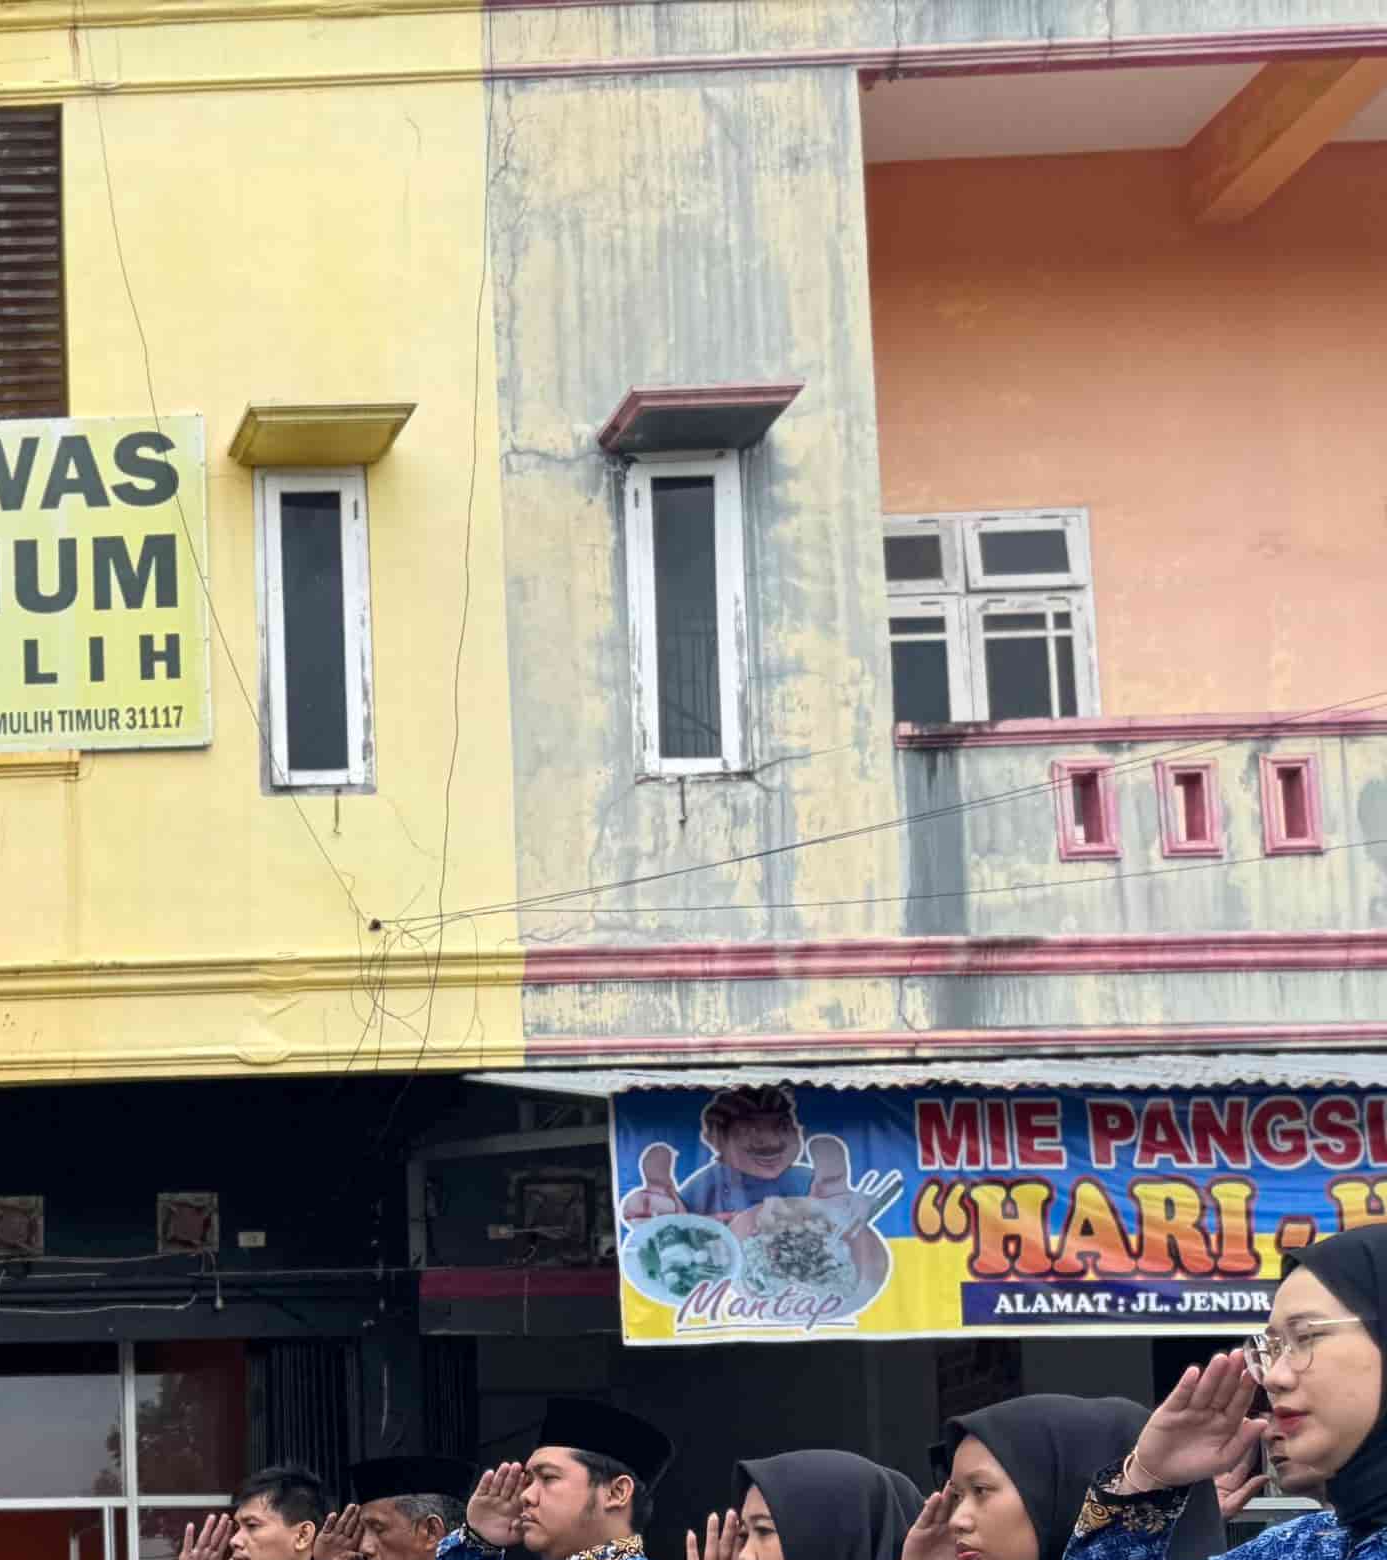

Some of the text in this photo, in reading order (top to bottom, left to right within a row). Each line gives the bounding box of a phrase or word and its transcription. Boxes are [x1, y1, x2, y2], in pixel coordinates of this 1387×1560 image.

[57, 707, 120, 732] TIMUR
[126, 705, 183, 730] 31117
[915, 1098, 1067, 1170] MIE
[676, 1278, 844, 1331] Mantap
[993, 1292, 1112, 1314] ALAMAT
[1131, 1292, 1170, 1313] JL.
[1176, 1291, 1273, 1313] JENDR
